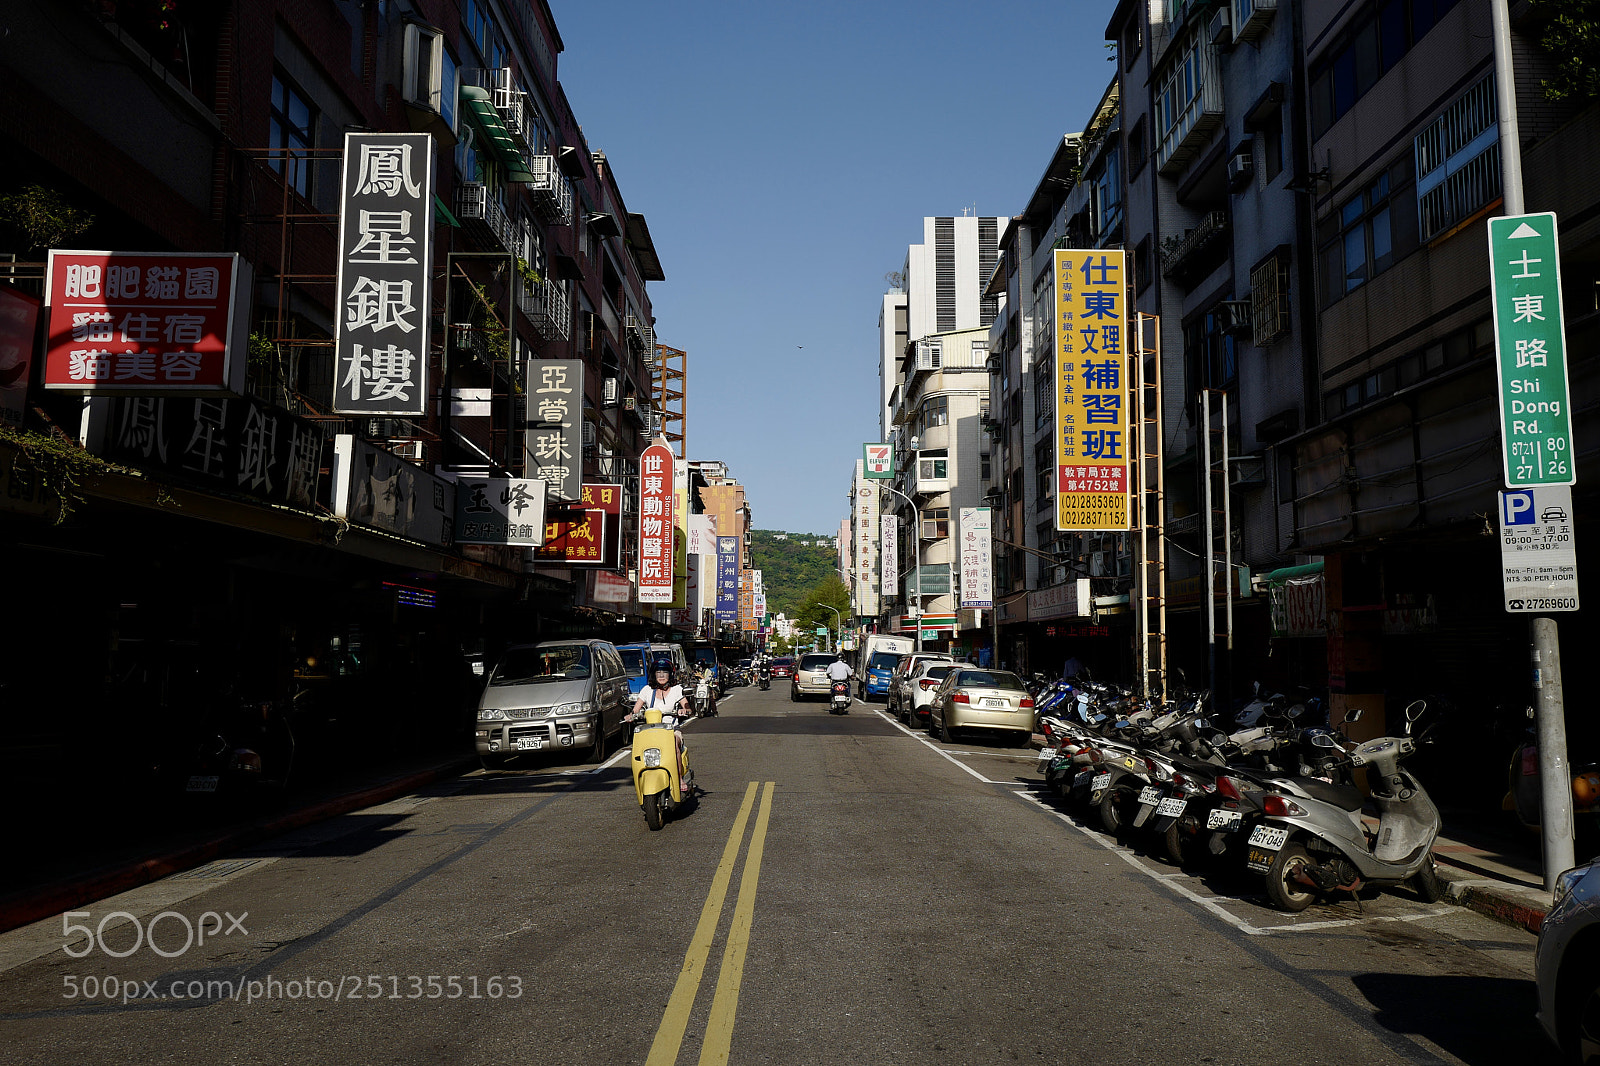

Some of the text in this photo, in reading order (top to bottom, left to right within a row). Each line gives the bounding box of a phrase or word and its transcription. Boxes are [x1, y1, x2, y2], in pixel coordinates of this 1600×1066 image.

[342, 143, 421, 403] 鳳星銀樓
[65, 264, 219, 300] 肥肥貓園
[1508, 250, 1549, 369] 士東路
[71, 312, 206, 343] 貓住宿
[68, 349, 203, 381] 貓美容
[1079, 255, 1122, 461] 仕東文理補習班
[1510, 378, 1540, 394] Shi
[1512, 400, 1561, 417] Dong
[1513, 420, 1543, 435] Rd.
[1547, 437, 1566, 451] 80
[1064, 467, 1122, 479] 教育局立案
[1516, 465, 1533, 480] 27
[1548, 460, 1567, 475] 26
[1067, 480, 1119, 492] 第4752號
[464, 483, 534, 517] 玉峰
[1061, 495, 1125, 509] (02)28353601
[1506, 493, 1532, 524] P
[642, 455, 664, 578] 世東動物醫院
[1061, 511, 1125, 526] (02)28371152
